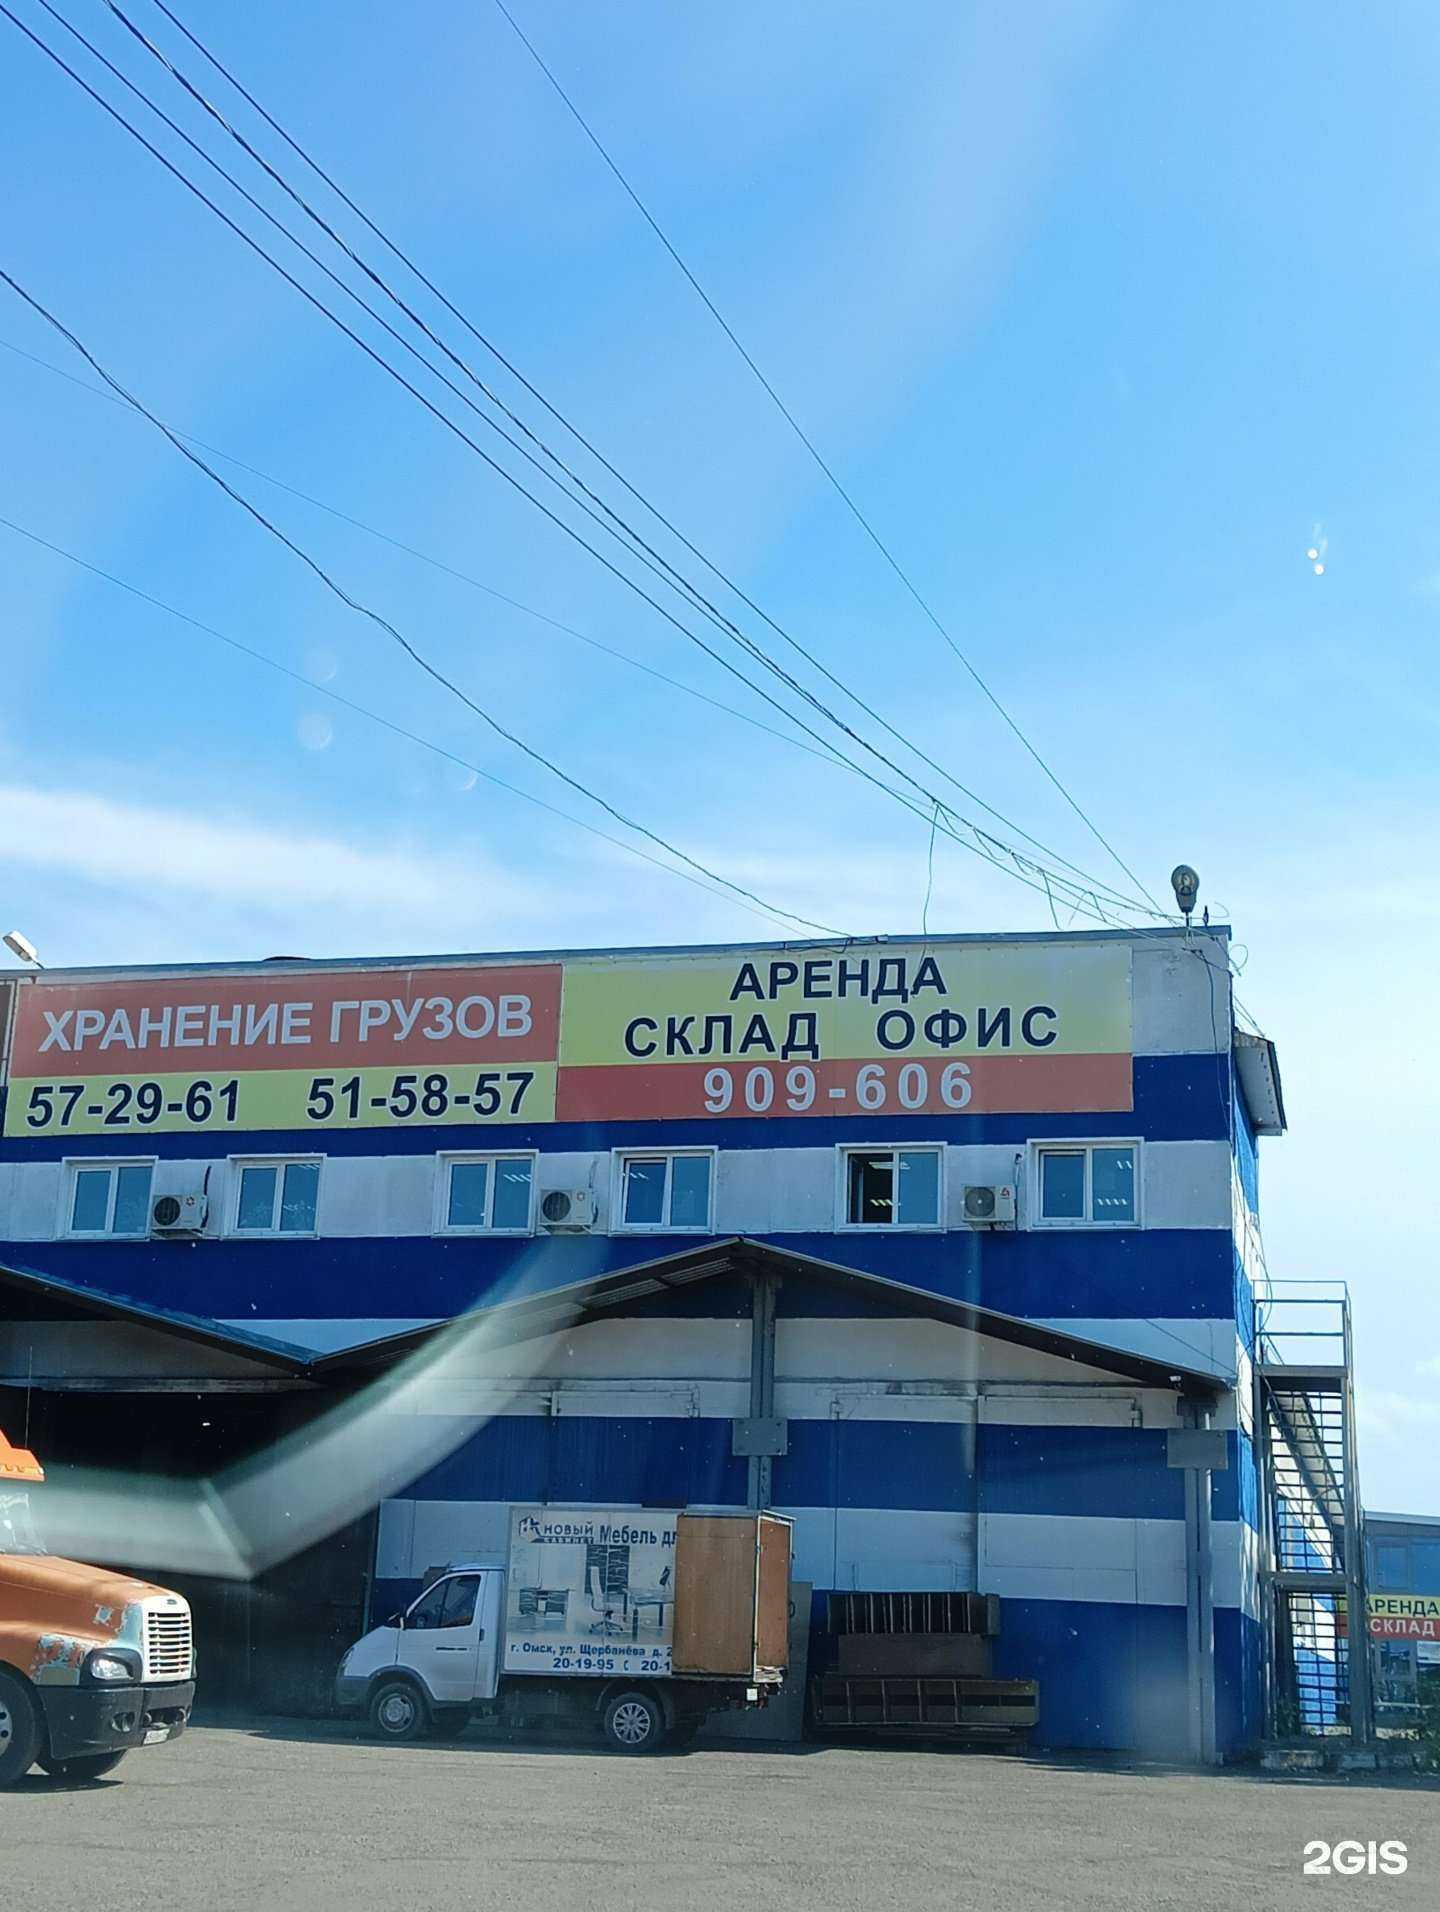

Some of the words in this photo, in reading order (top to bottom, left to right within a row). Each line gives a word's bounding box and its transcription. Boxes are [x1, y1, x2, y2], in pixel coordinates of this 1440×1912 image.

[730, 956, 946, 1004] АРЕНДА
[38, 1001, 314, 1053] ХРАНЕНИЕ
[329, 993, 533, 1042] ГРУЗОВ
[624, 1012, 820, 1060] СКЛАД
[875, 1006, 1059, 1051] ОФИС
[26, 1079, 239, 1129] 57-29-61
[306, 1071, 534, 1121] 51-58-57
[703, 1061, 973, 1114] 909-606
[600, 1524, 658, 1545] Мебель
[511, 1644, 520, 1652] г.
[522, 1642, 556, 1656] Омск,
[559, 1645, 576, 1656] ул.
[652, 1647, 663, 1657] д.
[1370, 1618, 1435, 1636] СКЛАД
[552, 1656, 614, 1670] 20-19-95
